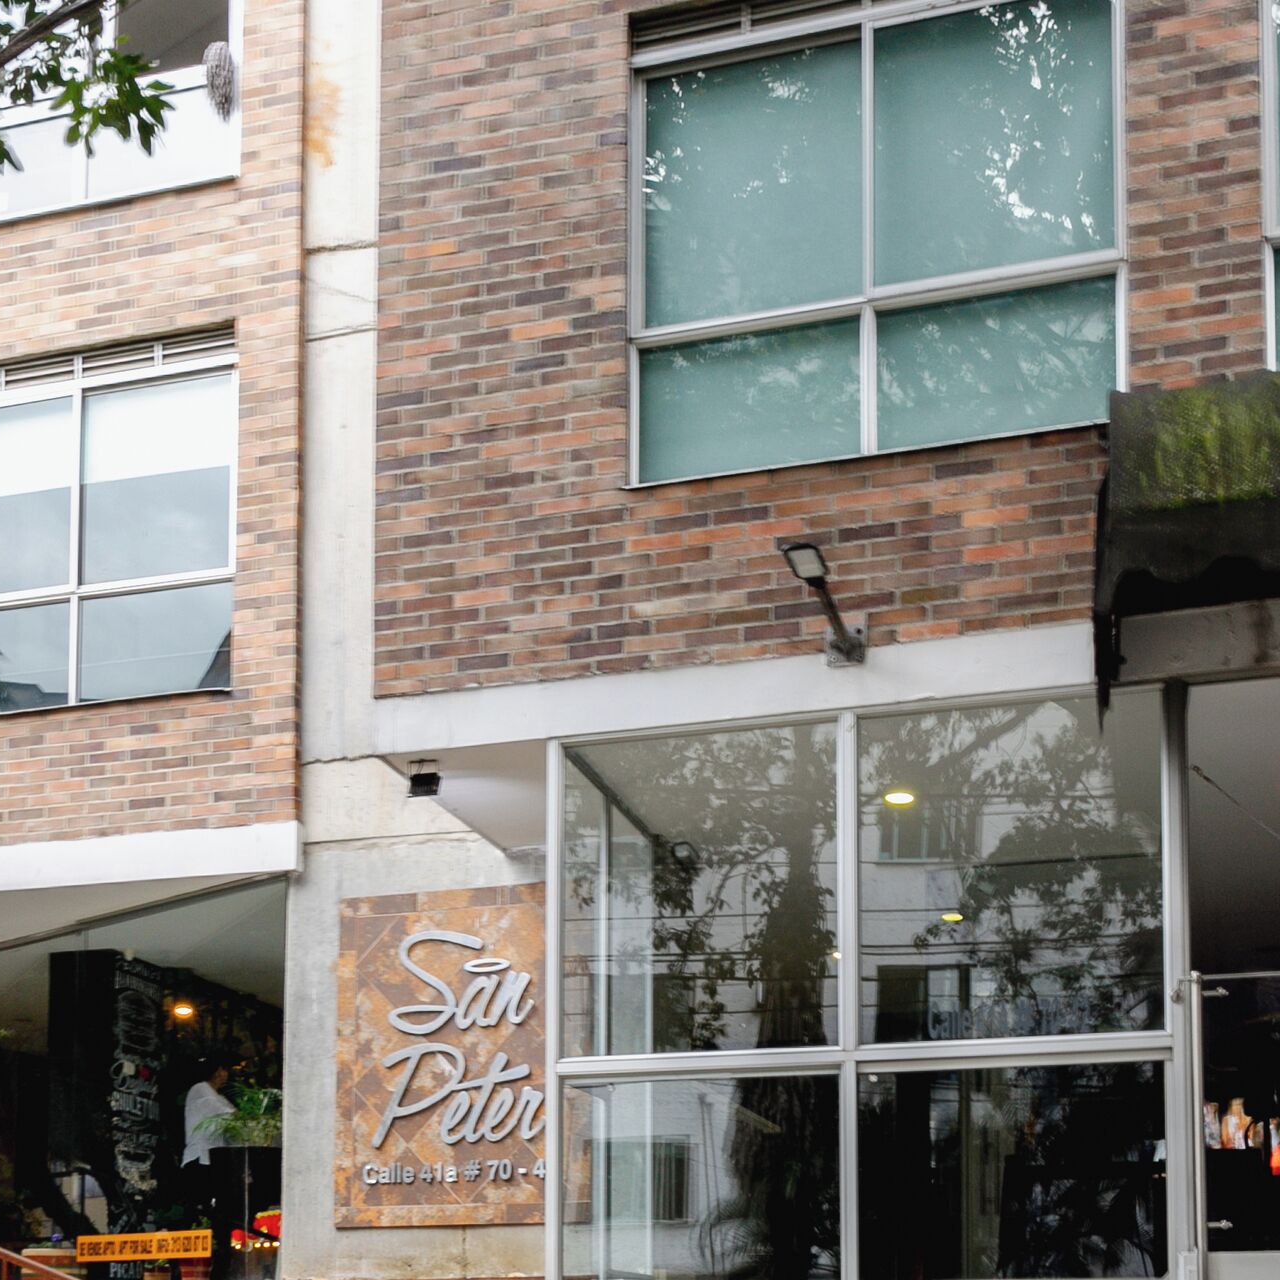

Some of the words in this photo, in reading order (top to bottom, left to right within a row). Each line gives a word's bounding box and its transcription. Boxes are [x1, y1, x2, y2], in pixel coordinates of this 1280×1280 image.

[387, 930, 535, 1035] San
[372, 1042, 545, 1149] Peter
[362, 1163, 415, 1184] Calle
[420, 1161, 458, 1183] 41a
[463, 1160, 481, 1180] #
[487, 1159, 513, 1181] 70
